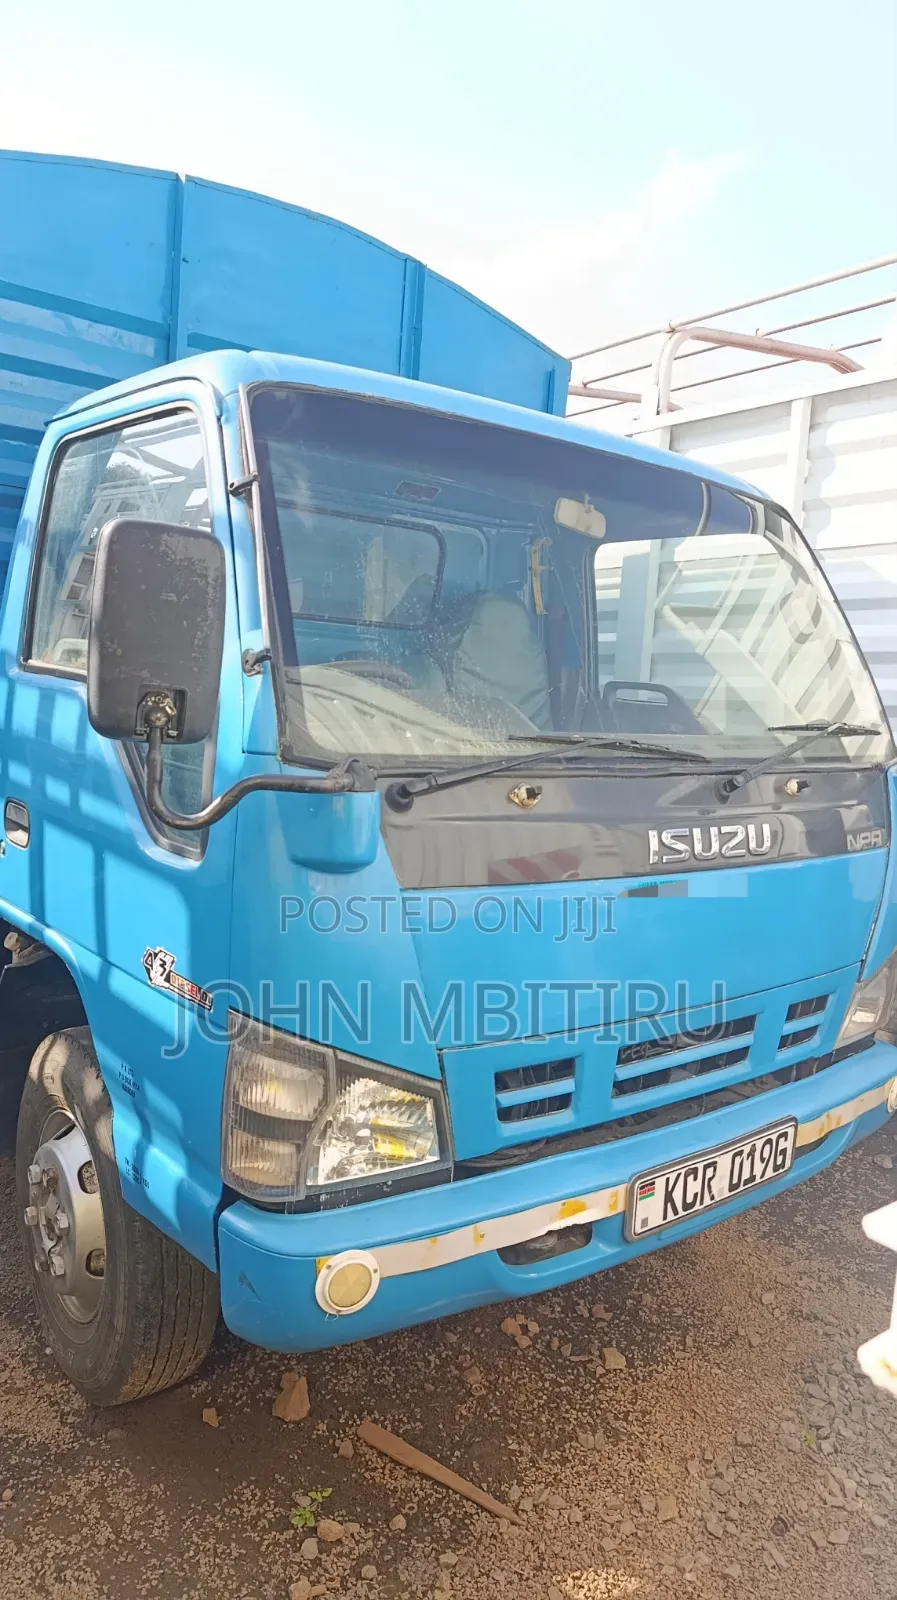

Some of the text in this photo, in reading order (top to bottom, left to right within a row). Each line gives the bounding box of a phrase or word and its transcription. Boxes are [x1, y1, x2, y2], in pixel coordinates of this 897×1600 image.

[648, 823, 771, 865] ISUZU
[846, 829, 882, 851] NPR
[662, 1130, 789, 1222] KCR 019G
